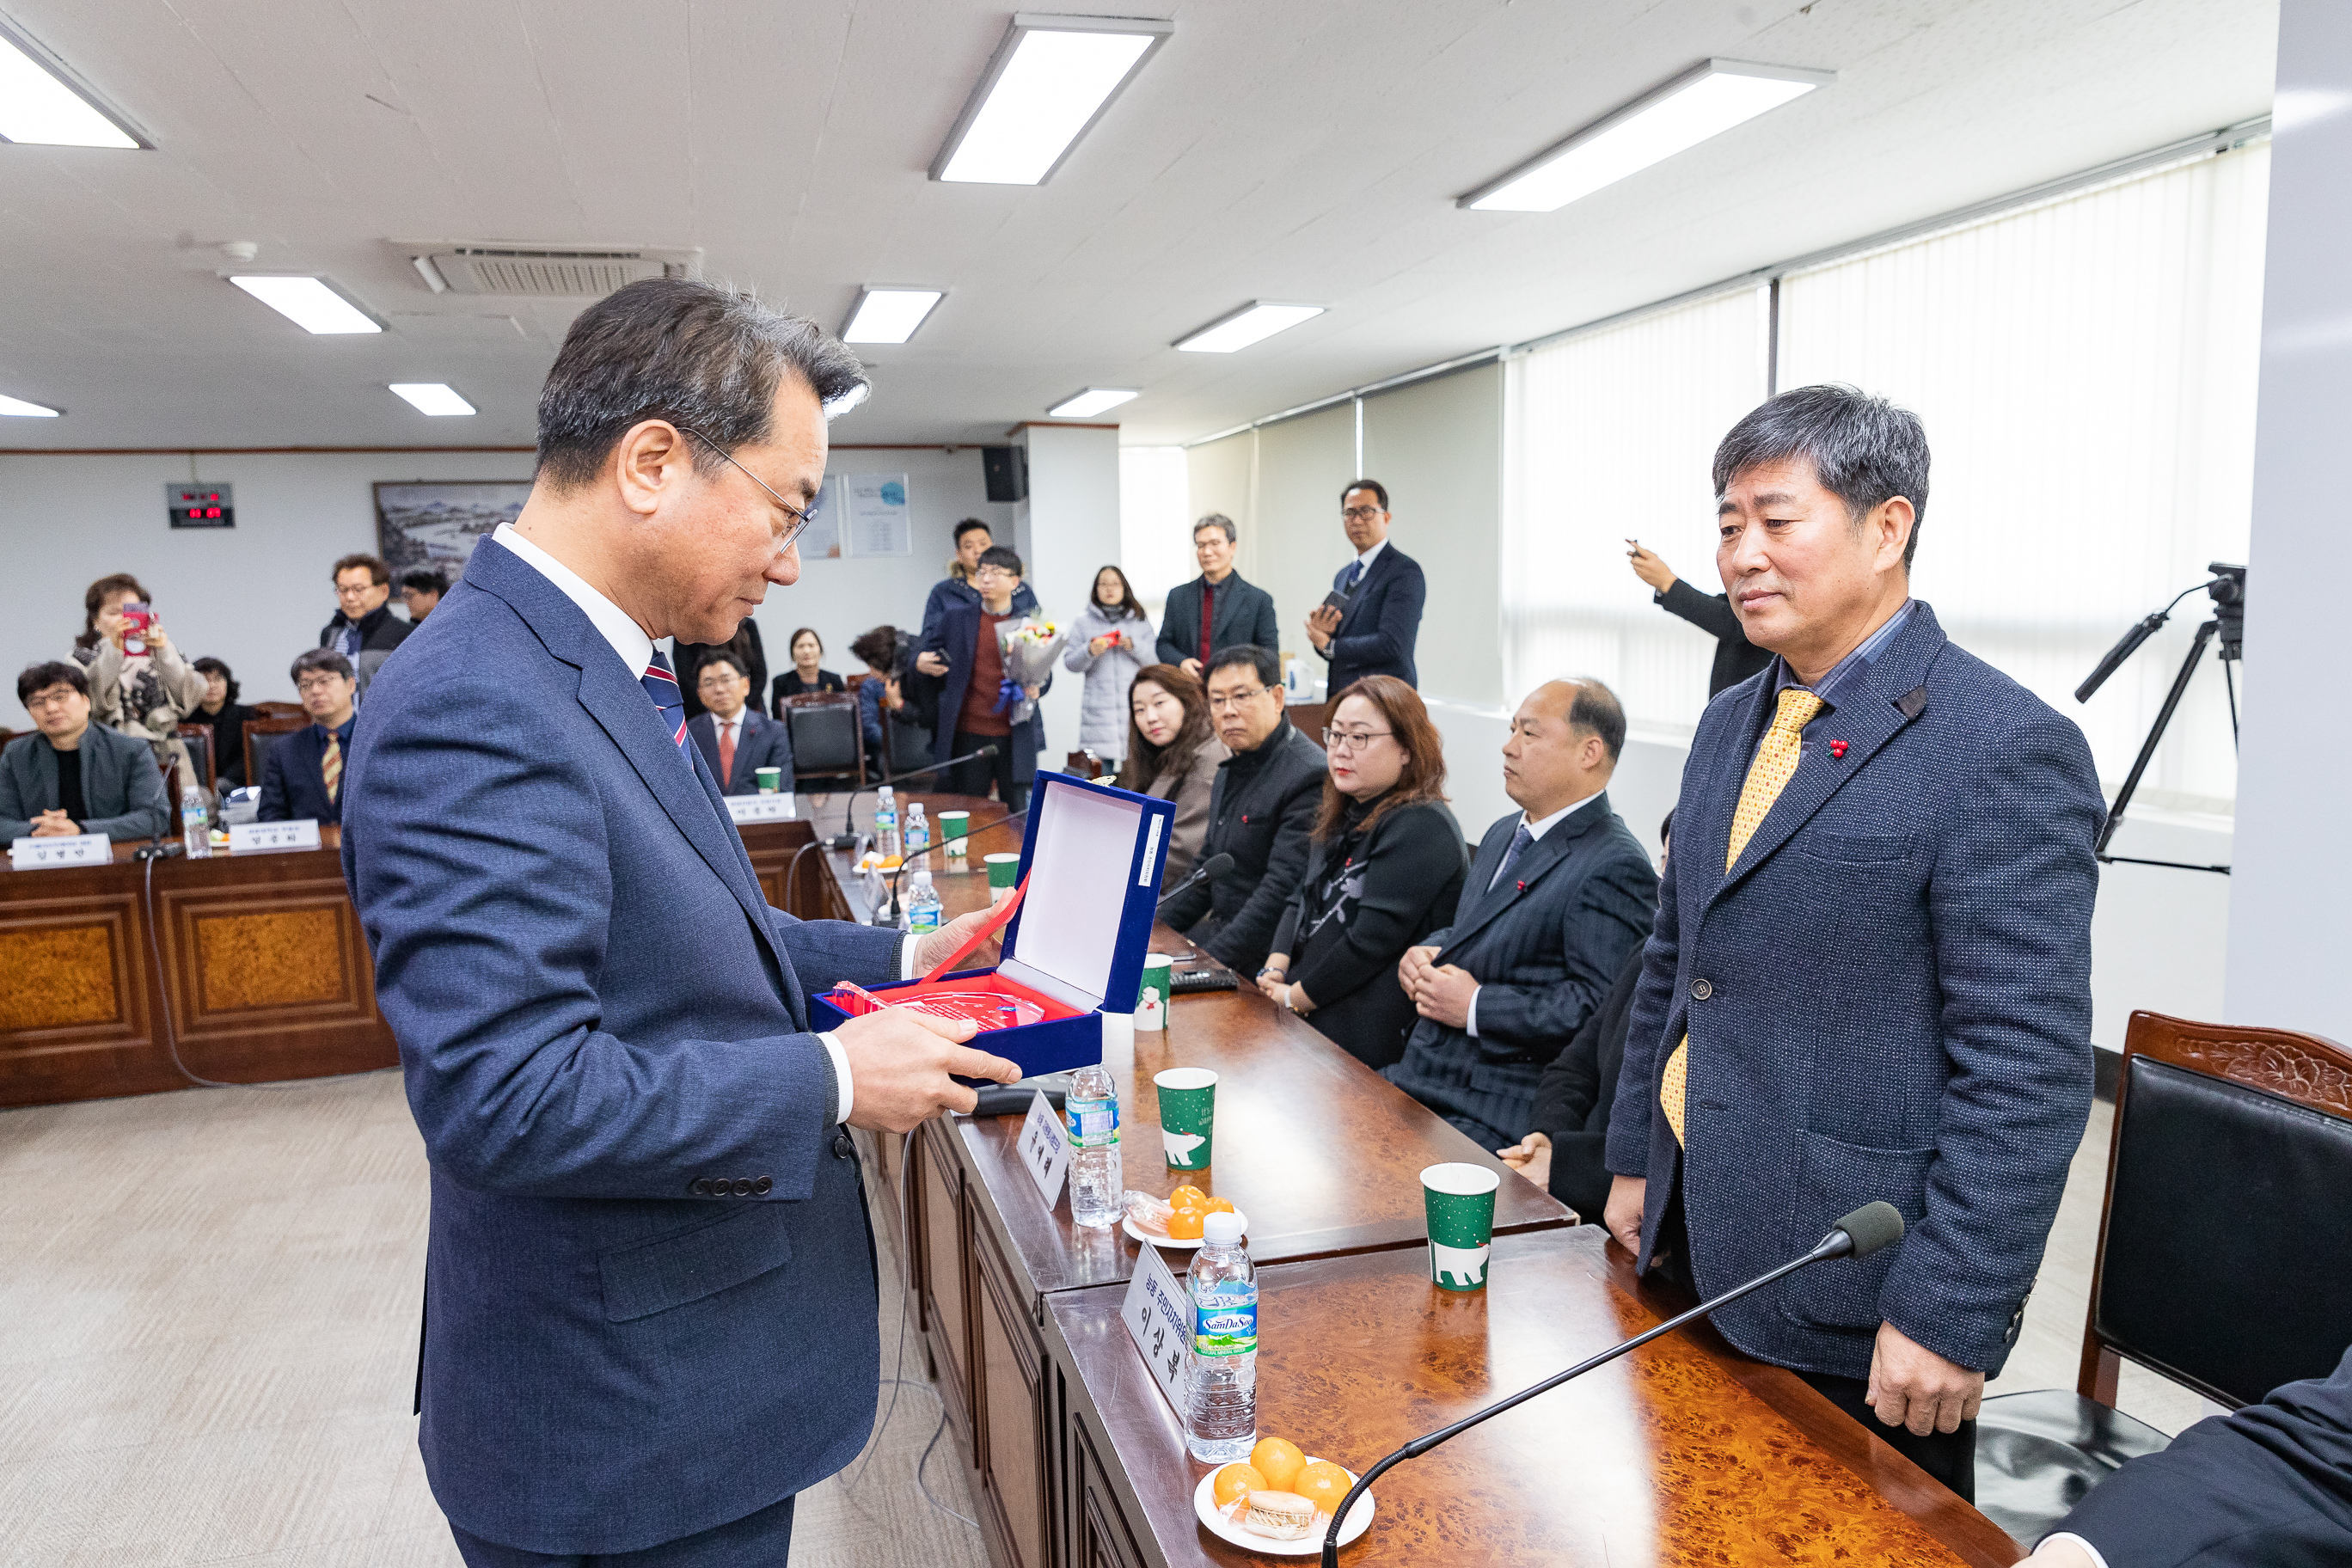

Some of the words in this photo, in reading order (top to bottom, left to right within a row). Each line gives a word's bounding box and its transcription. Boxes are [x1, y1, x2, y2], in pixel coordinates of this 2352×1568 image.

[1145, 1272, 1158, 1297] 능동
[1157, 1289, 1187, 1349] 주민자치위원
[1204, 1316, 1253, 1330] SamDaSoo
